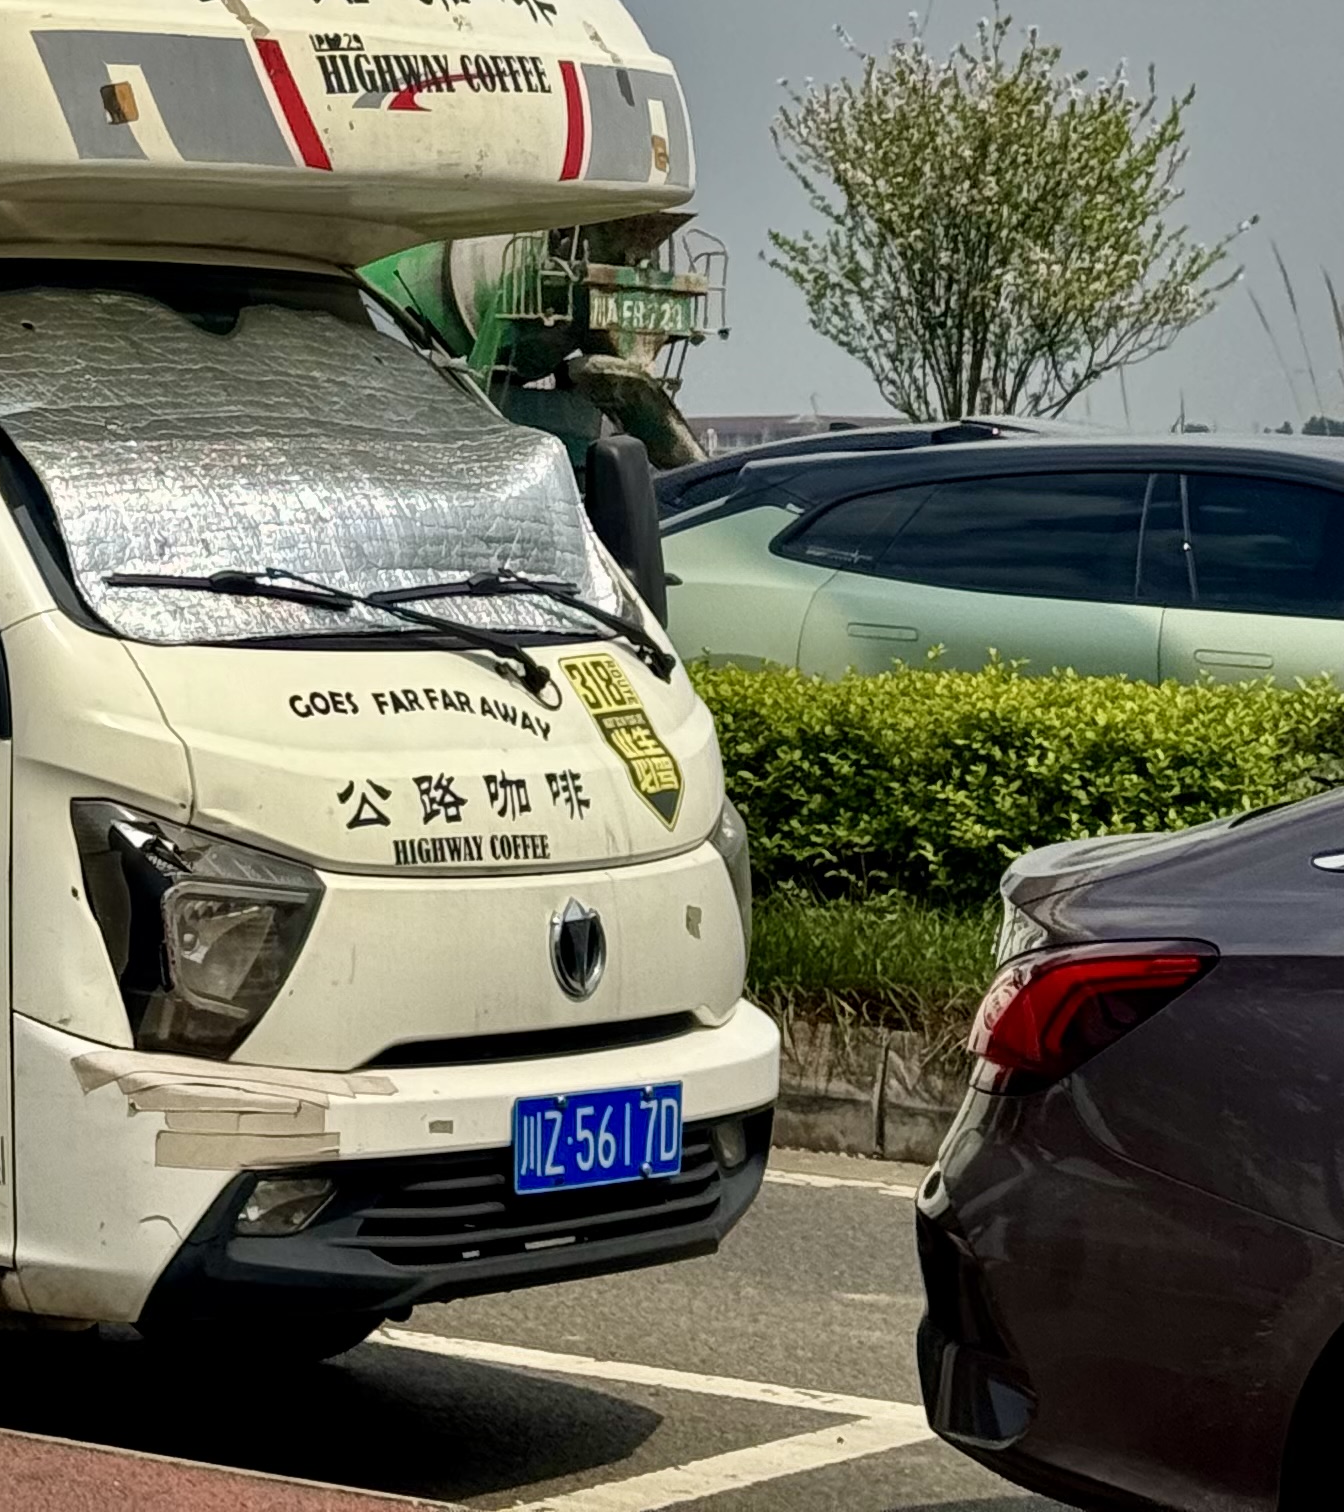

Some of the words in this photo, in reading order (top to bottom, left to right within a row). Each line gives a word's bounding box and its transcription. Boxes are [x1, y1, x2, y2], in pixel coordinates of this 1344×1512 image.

[316, 54, 455, 95] HIGHWAY
[460, 55, 552, 94] COFFEE
[289, 691, 359, 719] GOES
[371, 689, 425, 715] FAR
[427, 688, 476, 714] FAR
[479, 696, 551, 741] AWAY
[336, 768, 590, 830] 公路咖啡
[393, 835, 484, 866] HIGHWAY
[490, 834, 551, 860] COFFEE
